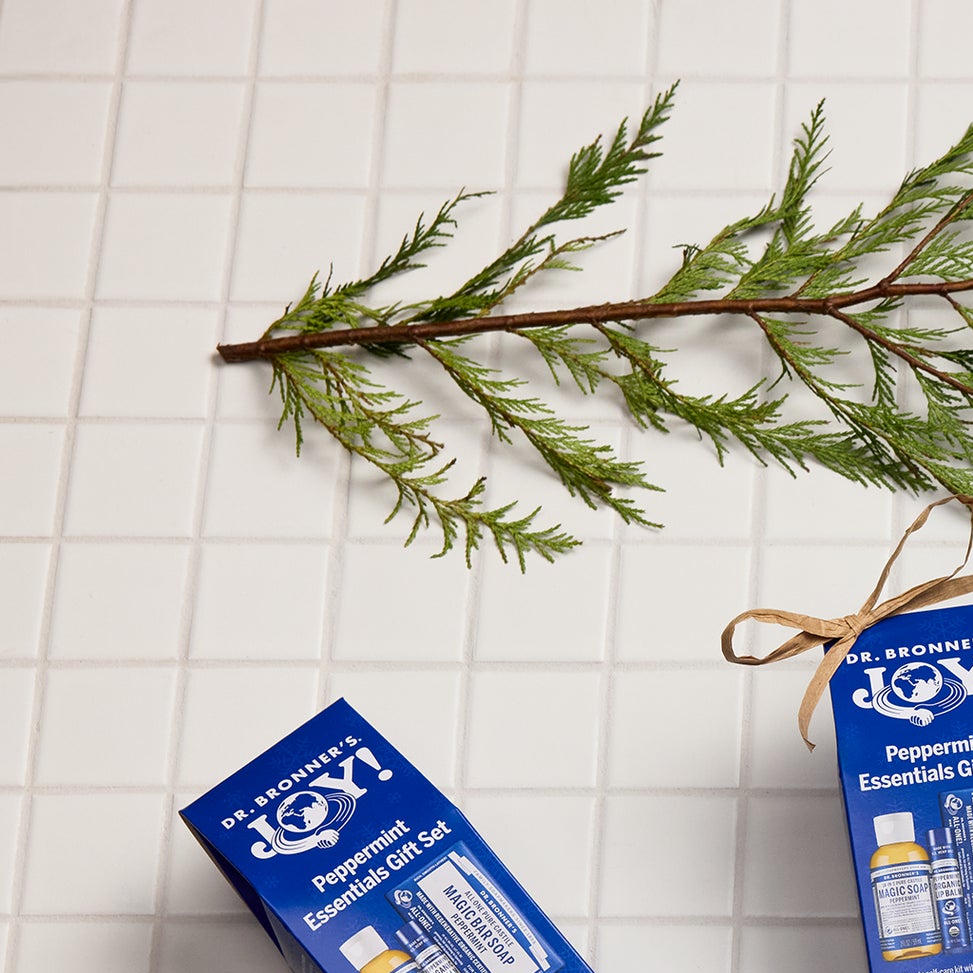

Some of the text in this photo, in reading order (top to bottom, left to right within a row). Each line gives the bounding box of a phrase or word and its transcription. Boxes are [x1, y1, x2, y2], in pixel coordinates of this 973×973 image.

[845, 651, 879, 664] DR.
[858, 763, 954, 791] Essentials
[247, 746, 394, 860] JOY!
[221, 808, 255, 830] DR.
[311, 819, 410, 892] Peppermint
[302, 820, 451, 930] Essentials Gift Set
[878, 882, 930, 898] MAGIC SOAP
[442, 884, 514, 964] MAGIC BAR SOAP
[954, 965, 963, 973] kit
